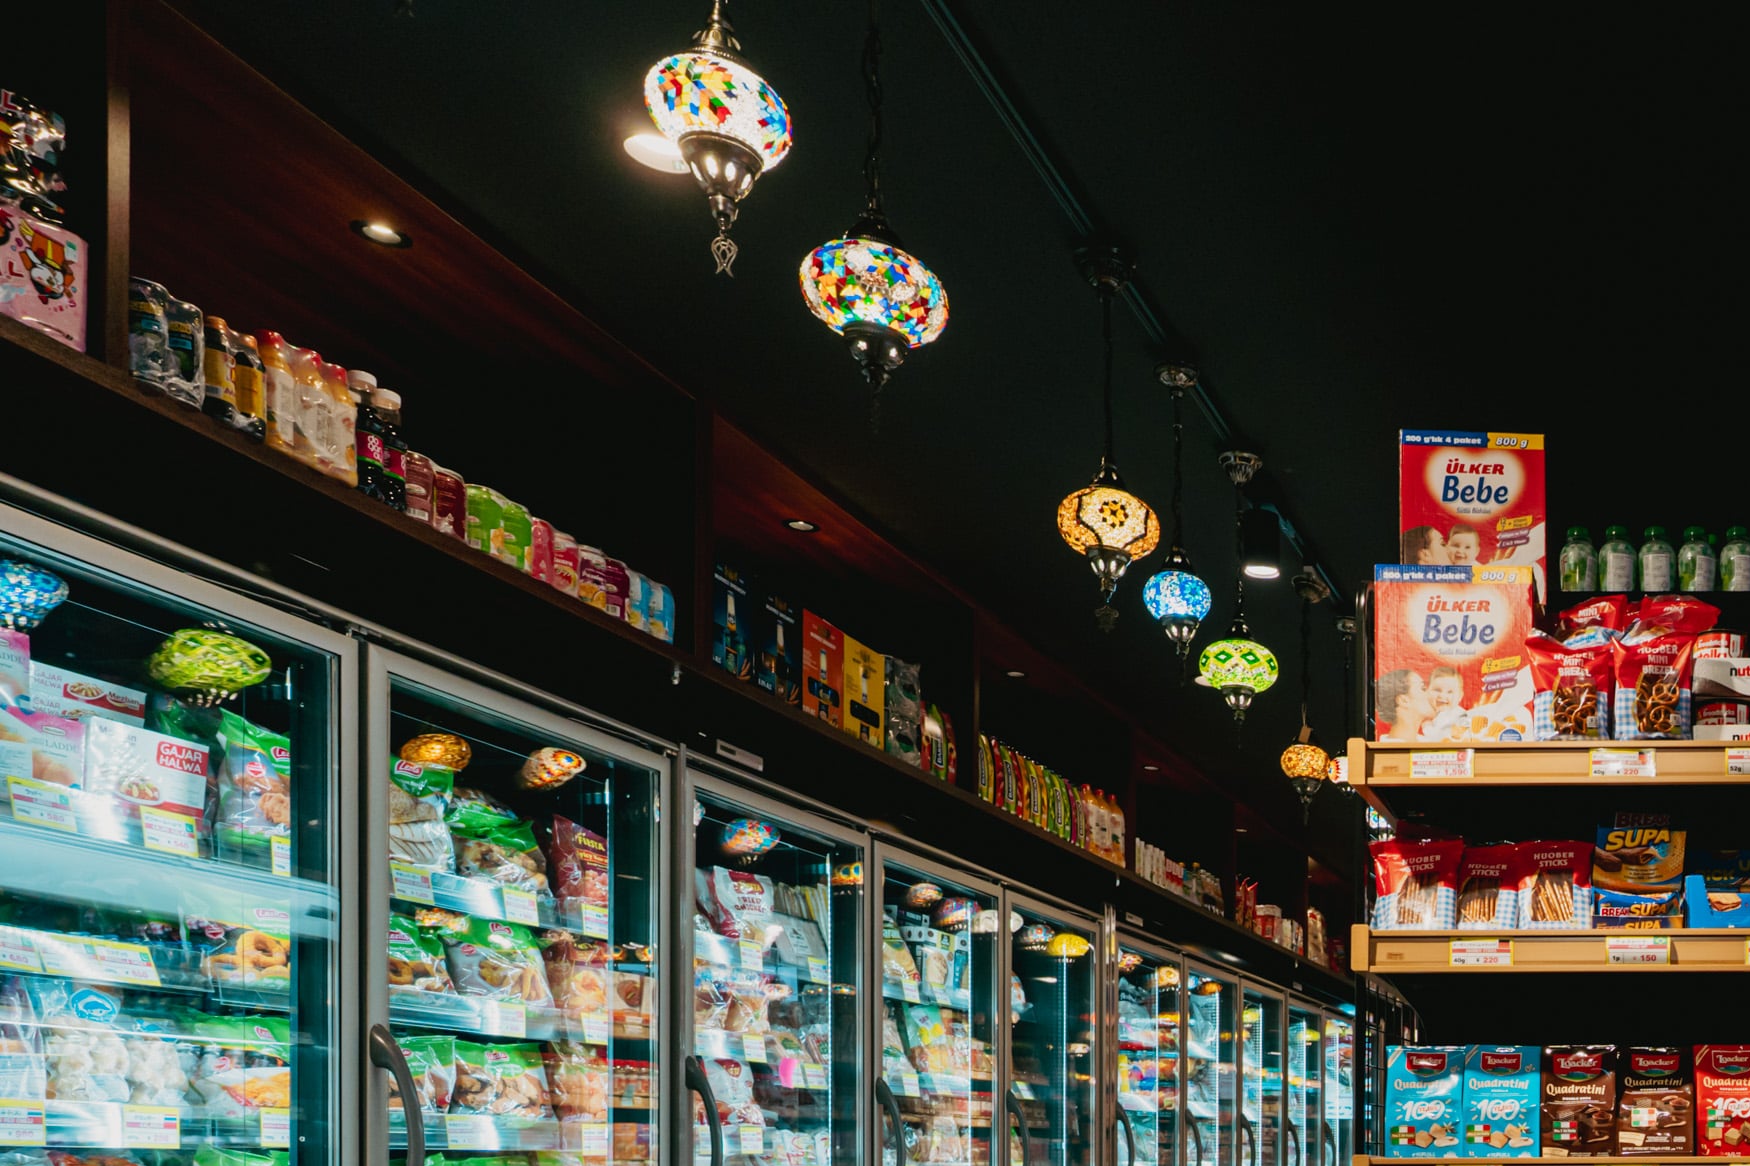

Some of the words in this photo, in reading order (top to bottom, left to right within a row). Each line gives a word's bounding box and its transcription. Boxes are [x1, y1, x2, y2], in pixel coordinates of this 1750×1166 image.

[1496, 438, 1516, 447] 800
[1519, 440, 1529, 449] g
[1445, 458, 1505, 475] ÜLKER
[1442, 475, 1509, 504] Bebe
[1481, 572, 1504, 581] 800
[1426, 596, 1491, 612] ÜLKER
[1422, 614, 1495, 645] Bebe
[1647, 654, 1669, 664] MINI
[159, 742, 203, 764] GAJAR
[158, 754, 202, 775] HALWA
[1606, 828, 1671, 850] SUPA
[1533, 851, 1575, 861] HUOBER
[1538, 859, 1568, 868] STICKS
[1470, 867, 1500, 877] STICKS
[1639, 954, 1656, 962] 150
[1468, 1078, 1530, 1091] Quadratini
[1624, 1076, 1684, 1089] Quadratini
[1546, 1083, 1606, 1097] Quadratini
